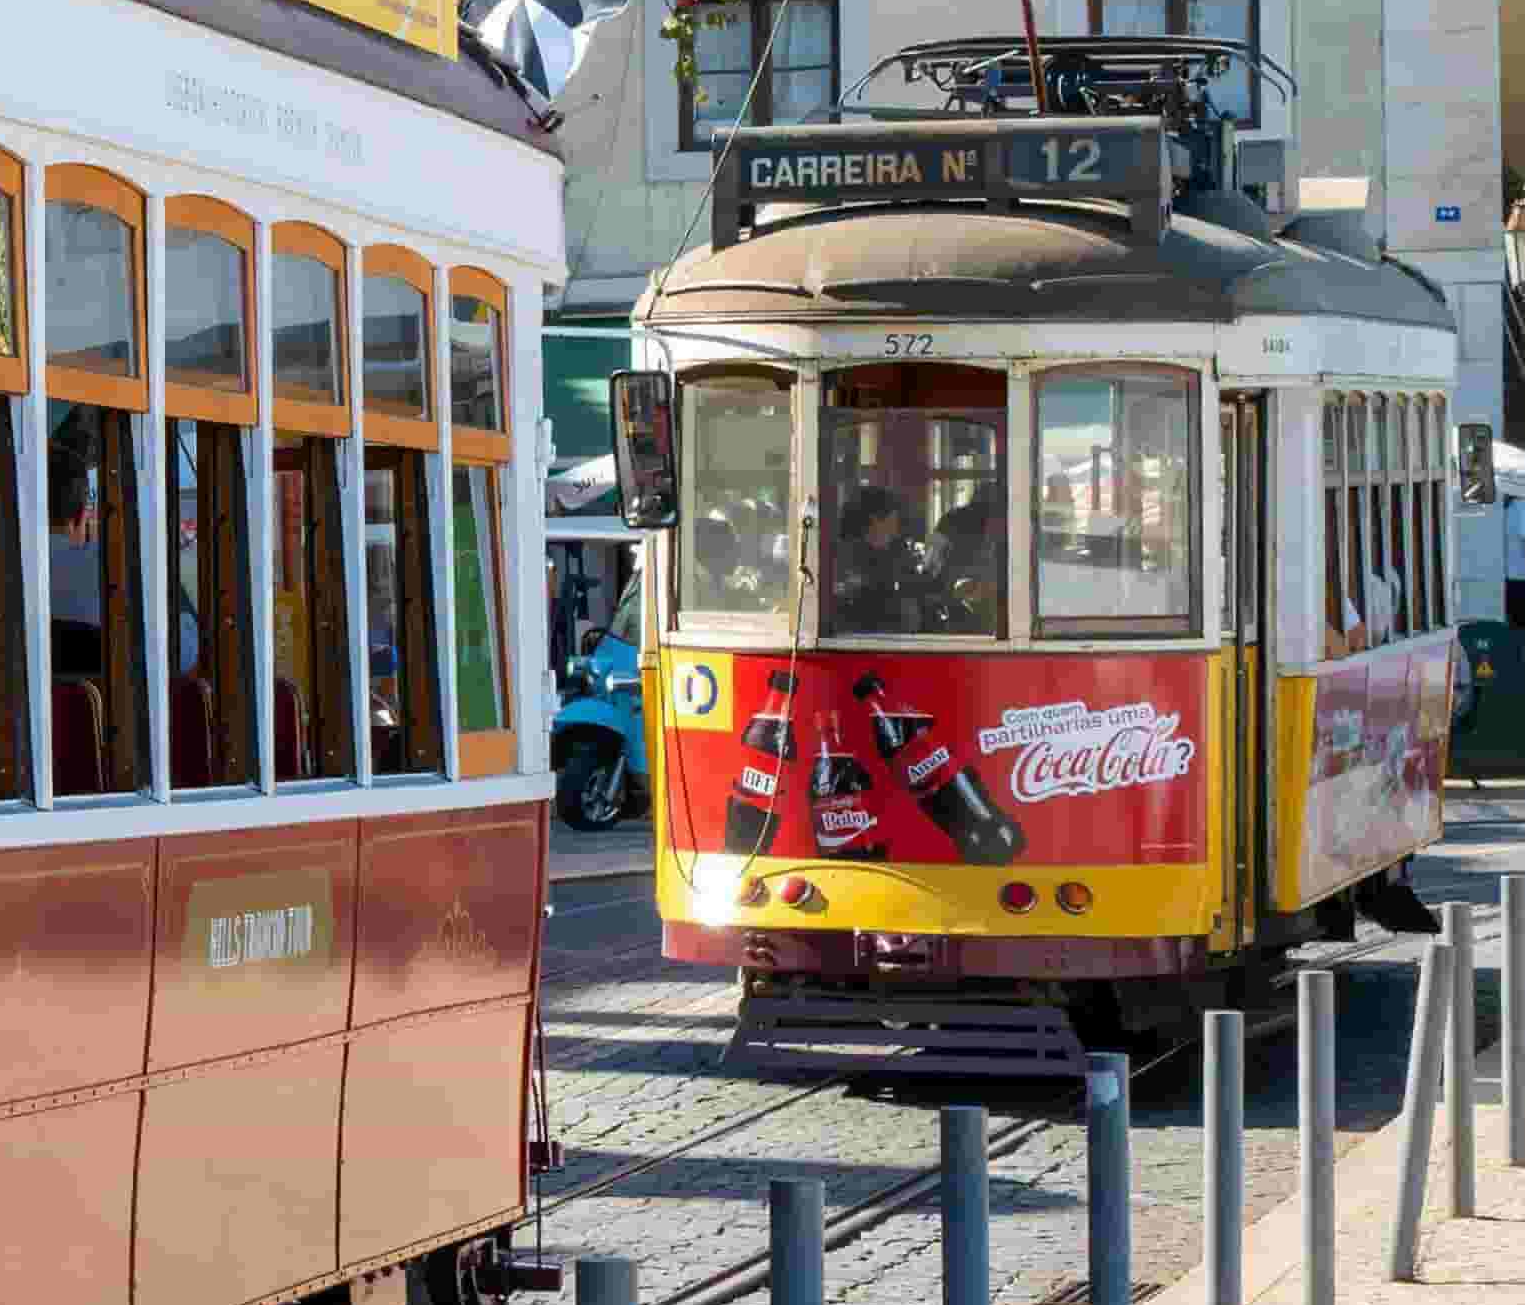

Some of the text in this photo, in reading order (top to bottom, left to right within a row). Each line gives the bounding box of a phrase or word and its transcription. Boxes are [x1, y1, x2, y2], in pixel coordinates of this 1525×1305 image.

[749, 149, 925, 189] CARREIRA
[1040, 137, 1102, 183] 12
[883, 333, 935, 357] 572
[1108, 706, 1152, 727] uma
